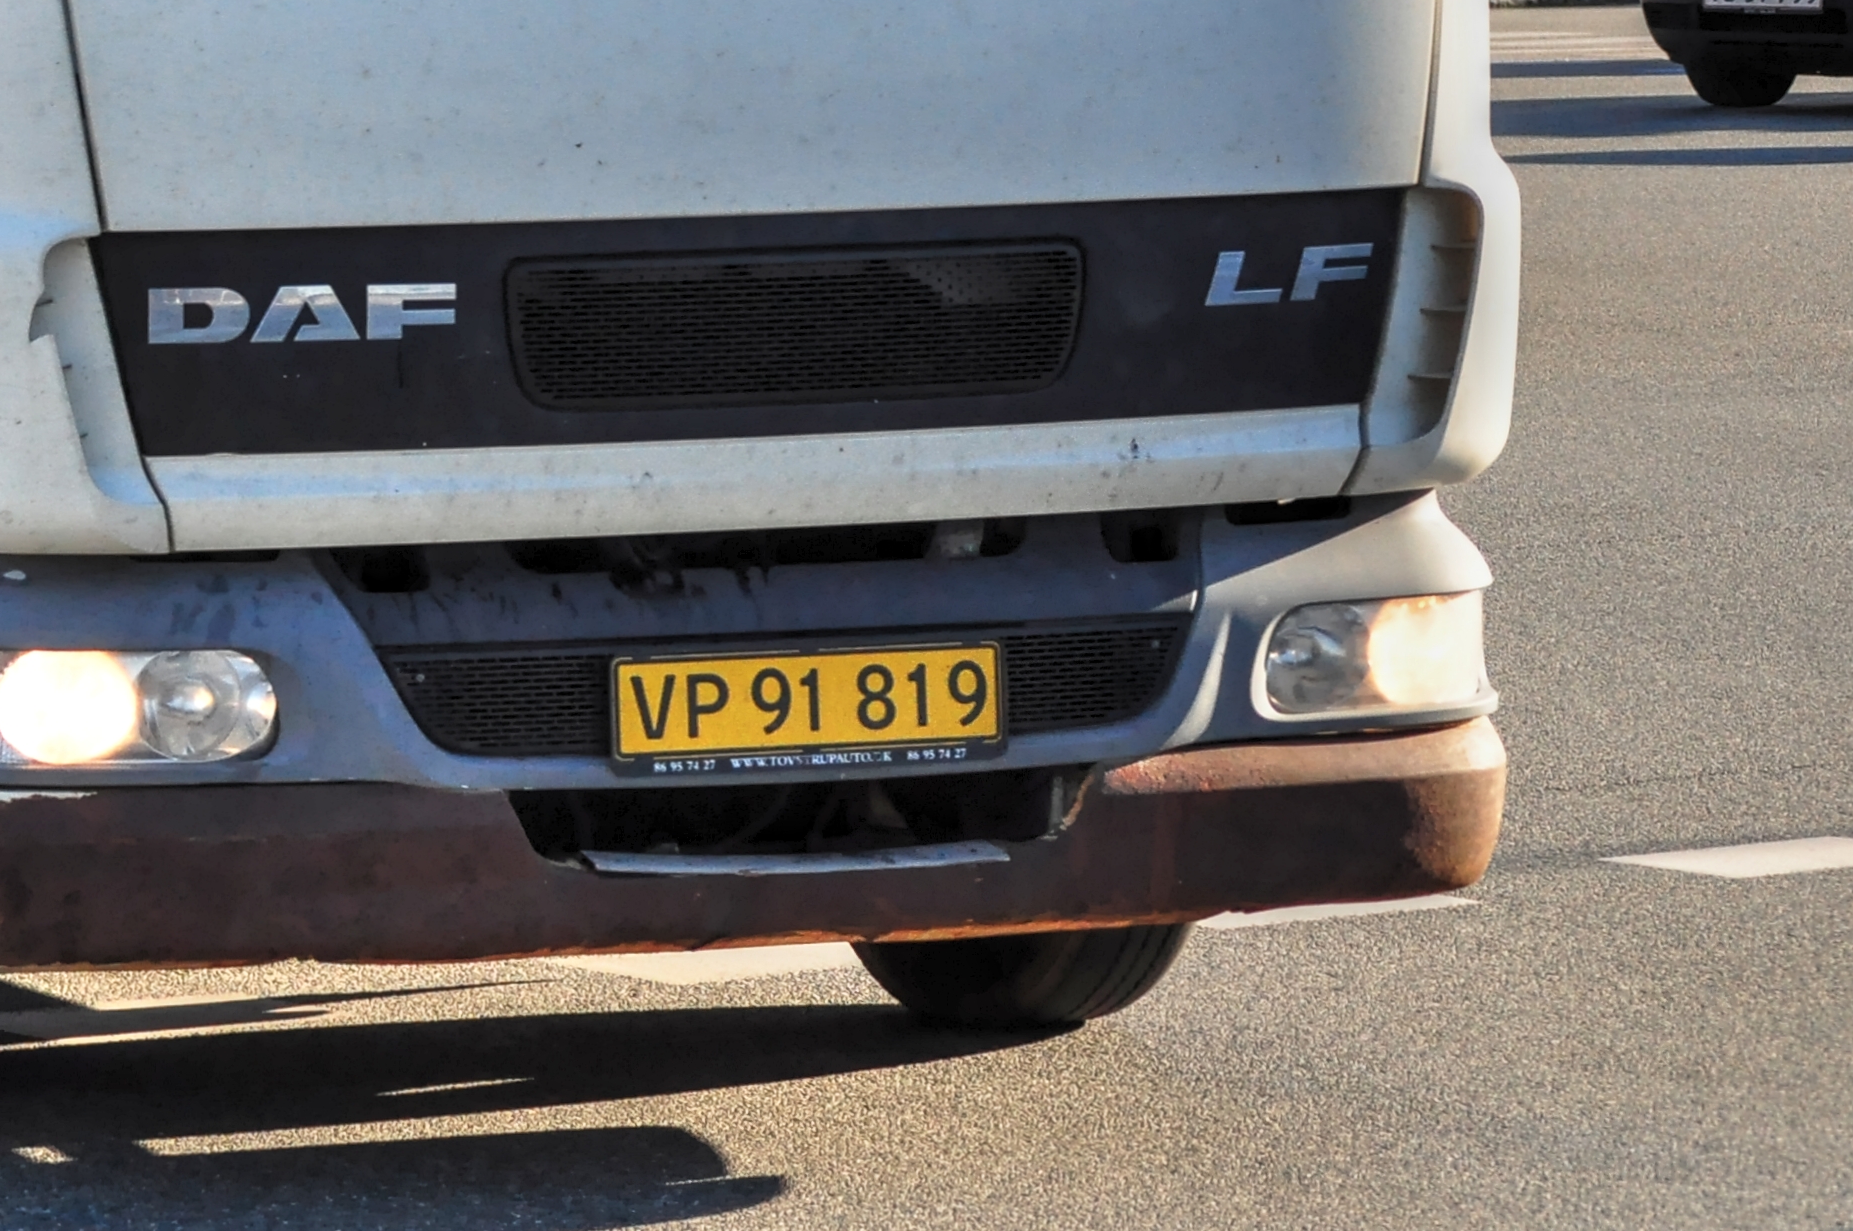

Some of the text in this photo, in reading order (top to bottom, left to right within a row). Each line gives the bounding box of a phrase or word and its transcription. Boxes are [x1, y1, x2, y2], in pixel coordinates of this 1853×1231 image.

[1204, 243, 1373, 307] LF
[148, 282, 457, 344] DAF
[630, 659, 988, 740] VP 91 819
